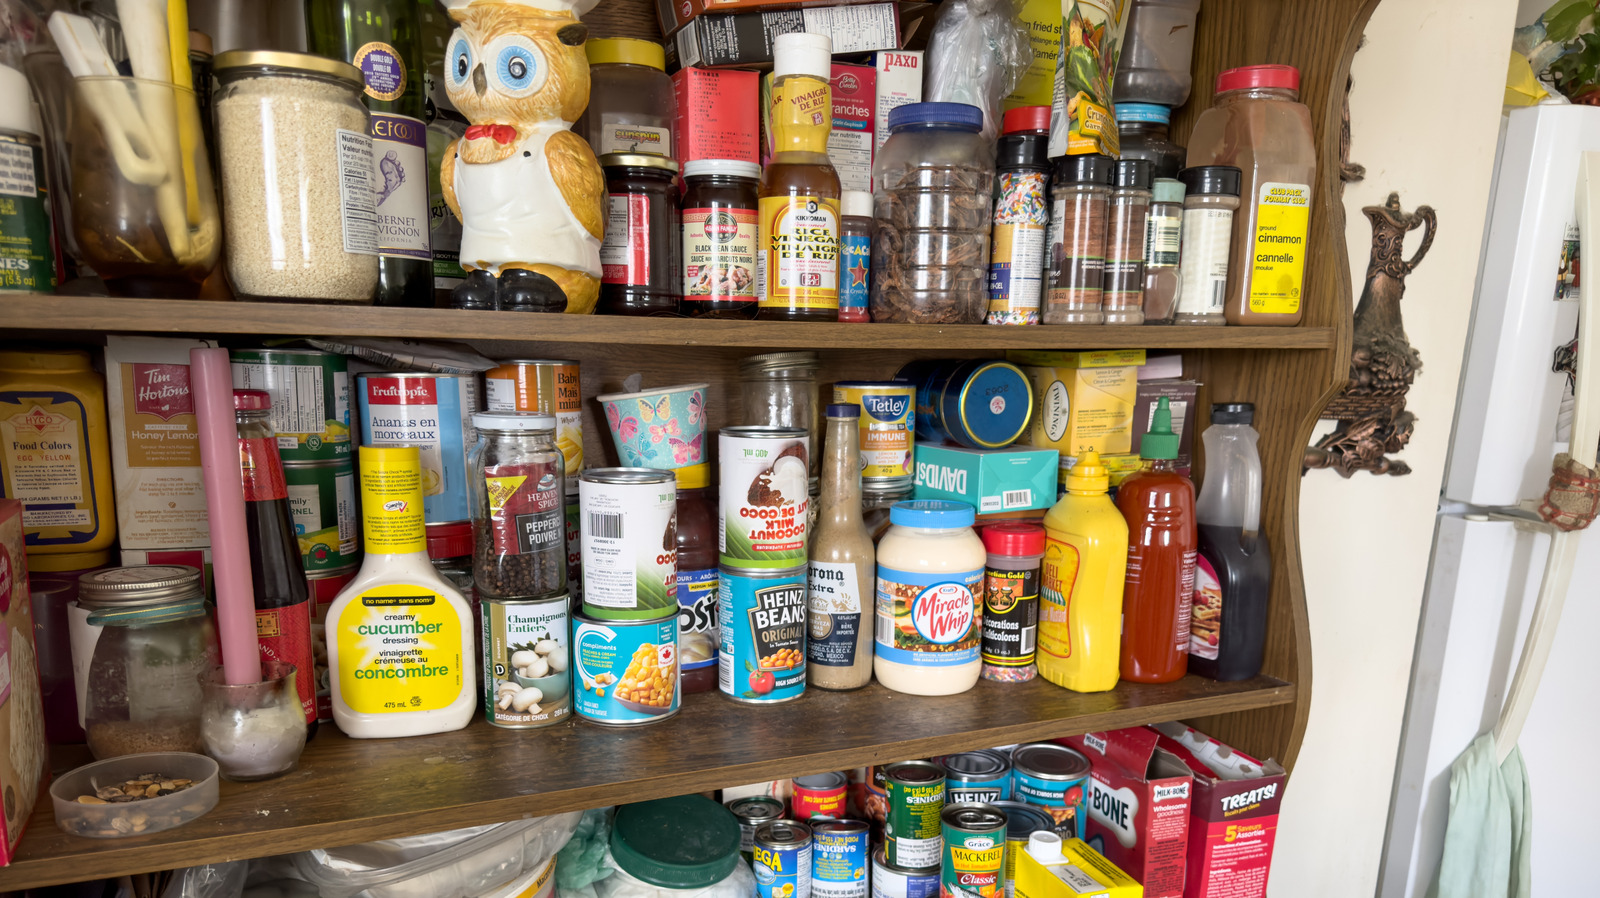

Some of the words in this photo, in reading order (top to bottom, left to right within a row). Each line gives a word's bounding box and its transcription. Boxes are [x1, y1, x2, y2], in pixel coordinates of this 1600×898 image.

[1033, 21, 1053, 33] fried
[884, 53, 918, 72] PAXO
[791, 87, 827, 105] VINAIGRE
[800, 101, 812, 111] DE
[812, 96, 825, 107] RIZ
[615, 130, 661, 144] sunspun
[1270, 188, 1286, 196] CLUB
[1286, 188, 1302, 197] PACK
[1264, 196, 1291, 204] FORMAT
[1292, 196, 1307, 205] CLUB
[378, 226, 420, 237] VIGNON
[771, 235, 840, 245] VINEGAR
[1258, 233, 1302, 244] cinnamon
[695, 245, 712, 253] BLACK
[770, 244, 841, 254] VINAIGRE
[740, 256, 753, 264] NOIRS
[1256, 253, 1294, 264] cannelle
[144, 368, 171, 385] Tim
[558, 373, 578, 387] Baby
[138, 386, 190, 402] Hortons
[869, 398, 907, 416] Tetley
[1050, 386, 1061, 437] TWININGS
[26, 416, 53, 425] HYCO
[372, 416, 417, 428] Ananas
[420, 418, 436, 427] en
[132, 430, 165, 442] Honey
[374, 430, 435, 440] morceaux
[868, 432, 906, 441] IMMUNE
[13, 442, 38, 451] Food
[40, 442, 72, 451] Colors
[756, 449, 769, 458] 400
[740, 508, 780, 519] COCO
[781, 507, 795, 518] DE
[766, 518, 795, 530] MILK
[528, 530, 558, 545] POIVRE
[749, 523, 805, 540] COCONUT
[1007, 572, 1025, 580] Gold
[808, 581, 835, 594] Extra
[763, 590, 805, 610] HEINZ
[916, 590, 970, 622] Miracle
[508, 612, 567, 625] Champignons
[755, 605, 806, 629] BEANS
[358, 622, 443, 635] cucumber
[508, 624, 547, 633] Entiers
[930, 610, 969, 640] Whip
[762, 626, 803, 643] ORIGINAL
[382, 637, 419, 645] dressing
[582, 642, 617, 651] compliments
[379, 648, 423, 657] vinaigrette
[374, 656, 416, 665] crémeuse
[354, 664, 449, 679] concombre
[531, 713, 549, 721] CHOIX
[1221, 783, 1278, 812] TREATS!
[1093, 786, 1129, 831] BONE
[1153, 803, 1188, 813] Wholesome
[1156, 810, 1184, 819] goodness
[1224, 825, 1238, 843] 5
[1237, 824, 1262, 832] Saveurs
[1236, 829, 1266, 840] Assorties
[954, 850, 1001, 863] MACKEREL
[960, 874, 997, 885] Classic
